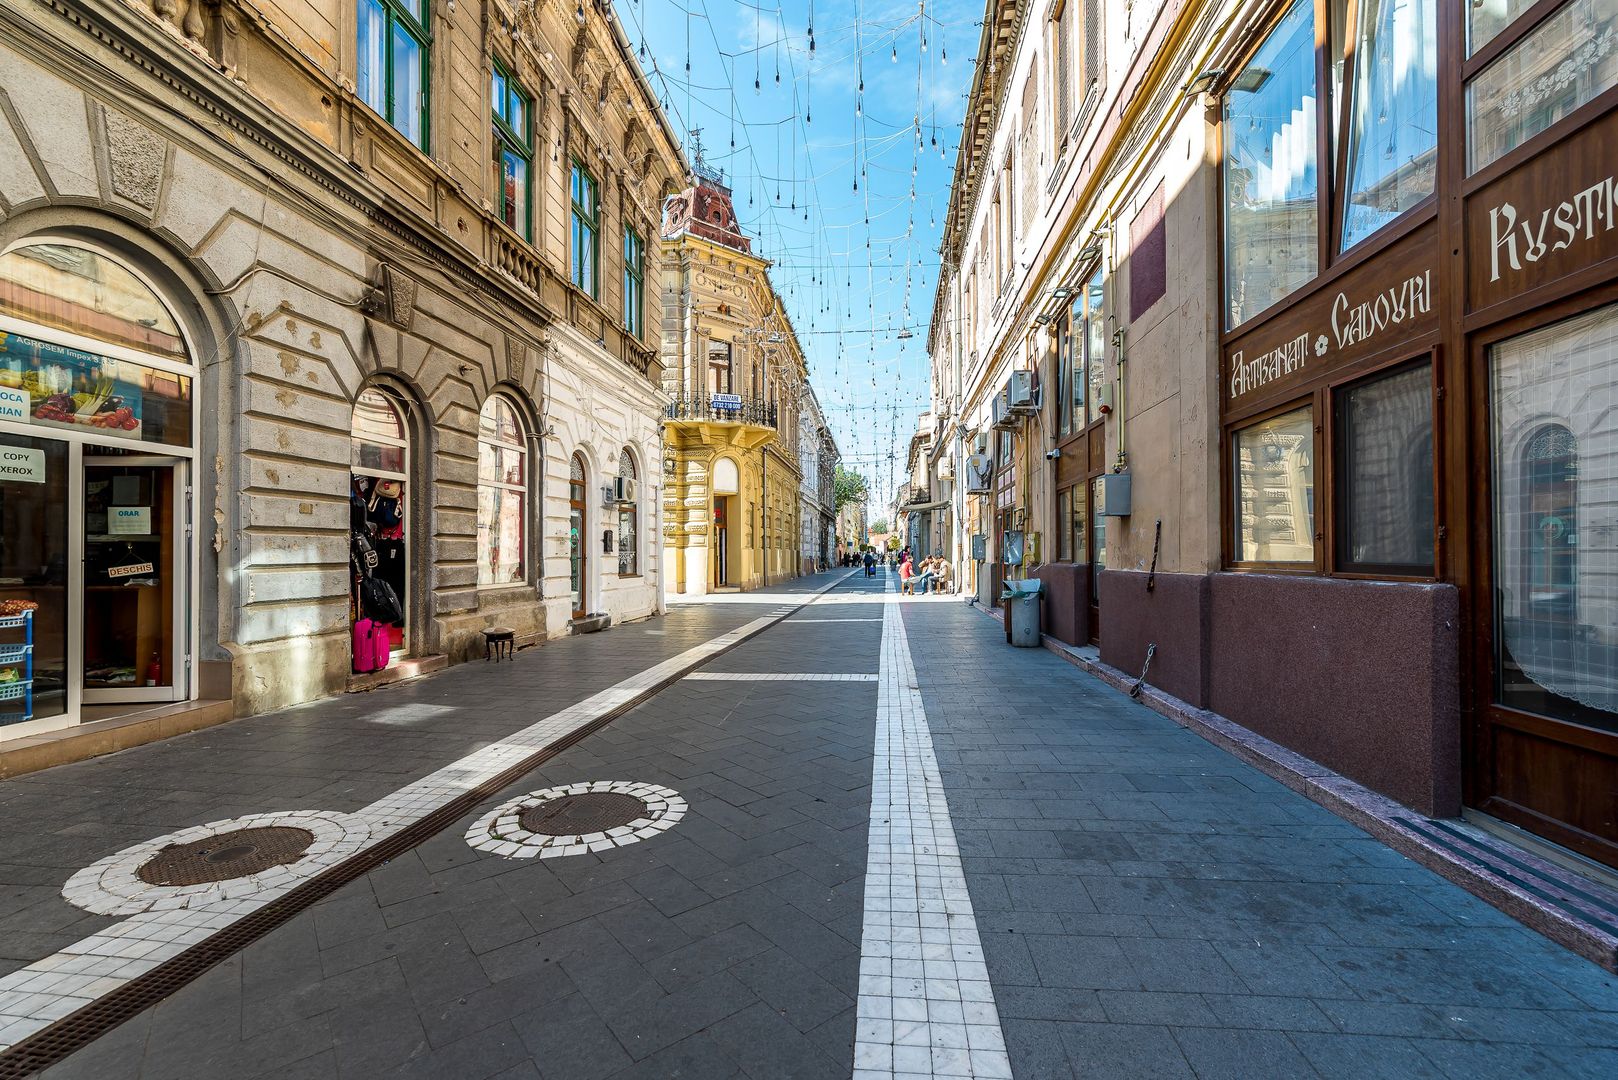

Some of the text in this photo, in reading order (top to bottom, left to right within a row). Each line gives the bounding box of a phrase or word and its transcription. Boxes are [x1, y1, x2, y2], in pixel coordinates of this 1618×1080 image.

[16, 336, 65, 355] AGROSEM
[66, 349, 92, 361] Impex
[3, 452, 30, 462] COPY
[0, 465, 33, 475] XEROX
[109, 564, 152, 577] DESCHIS
